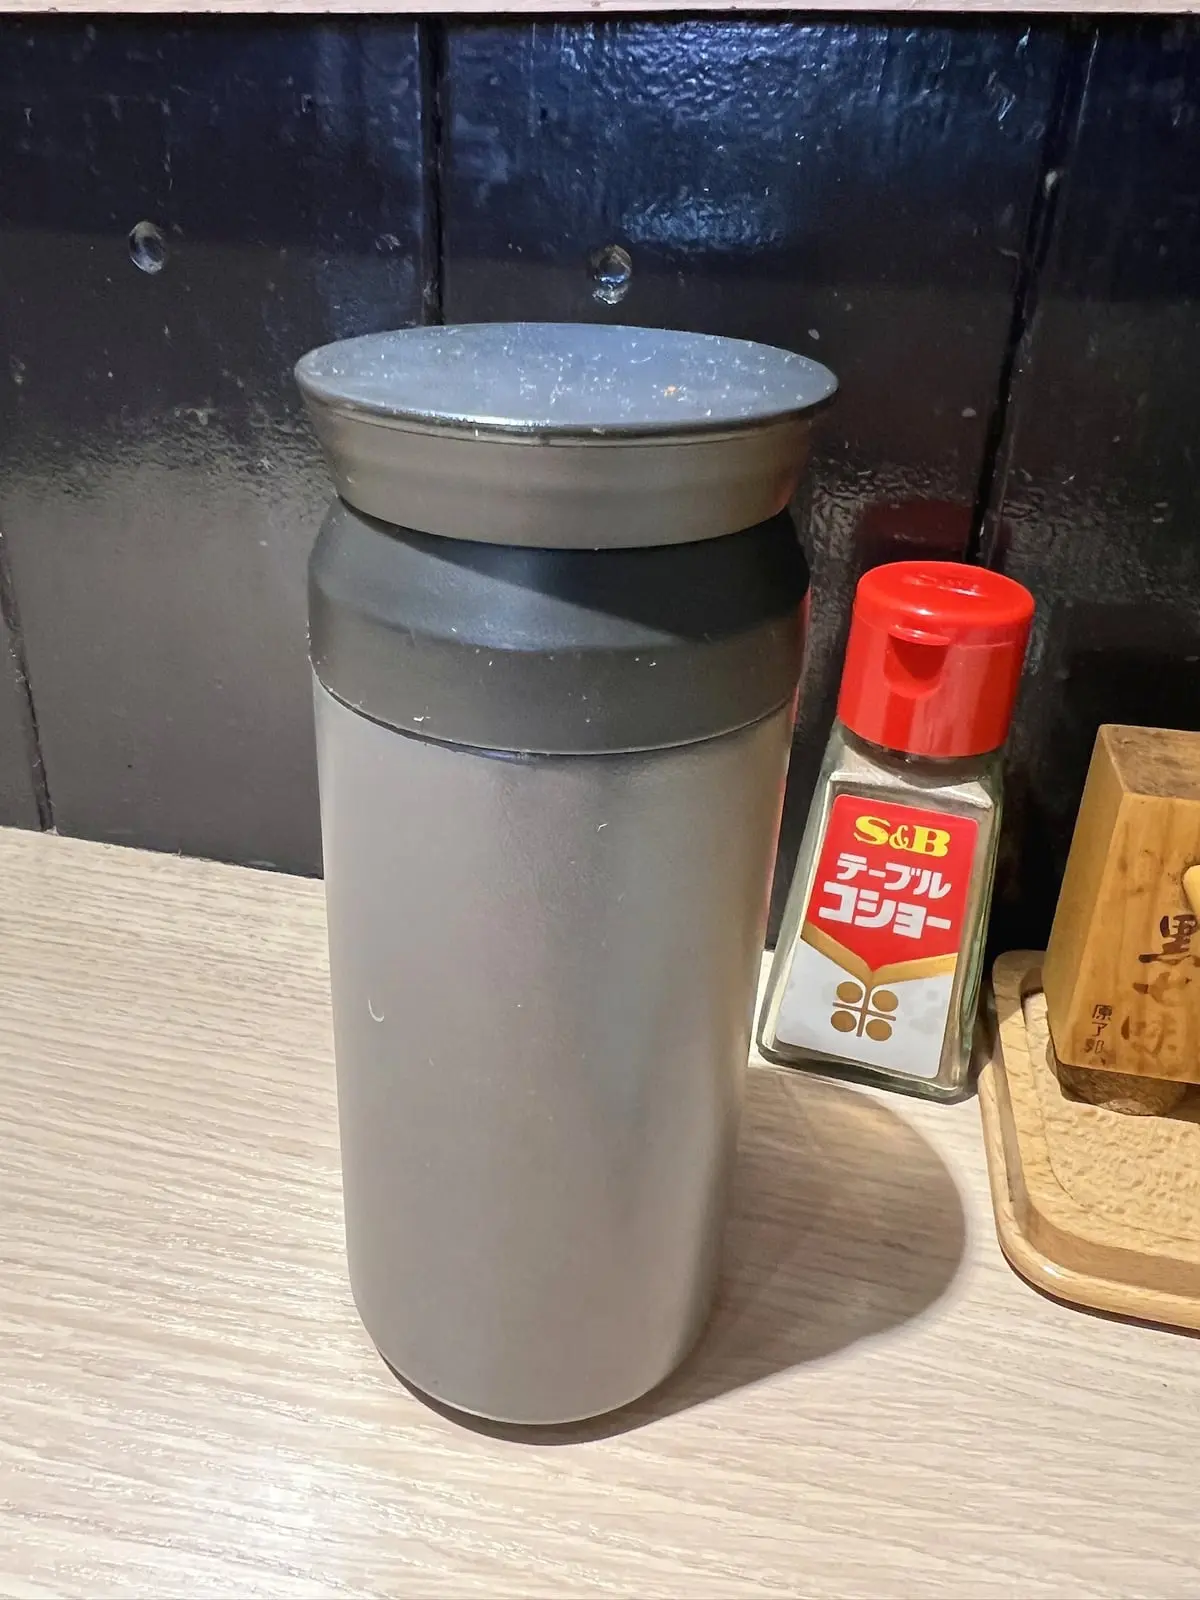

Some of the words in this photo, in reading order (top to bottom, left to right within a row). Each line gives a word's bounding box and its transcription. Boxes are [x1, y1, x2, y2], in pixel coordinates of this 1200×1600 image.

[853, 815, 951, 857] S&B
[836, 852, 952, 899] テーブル
[818, 881, 952, 939] コショー
